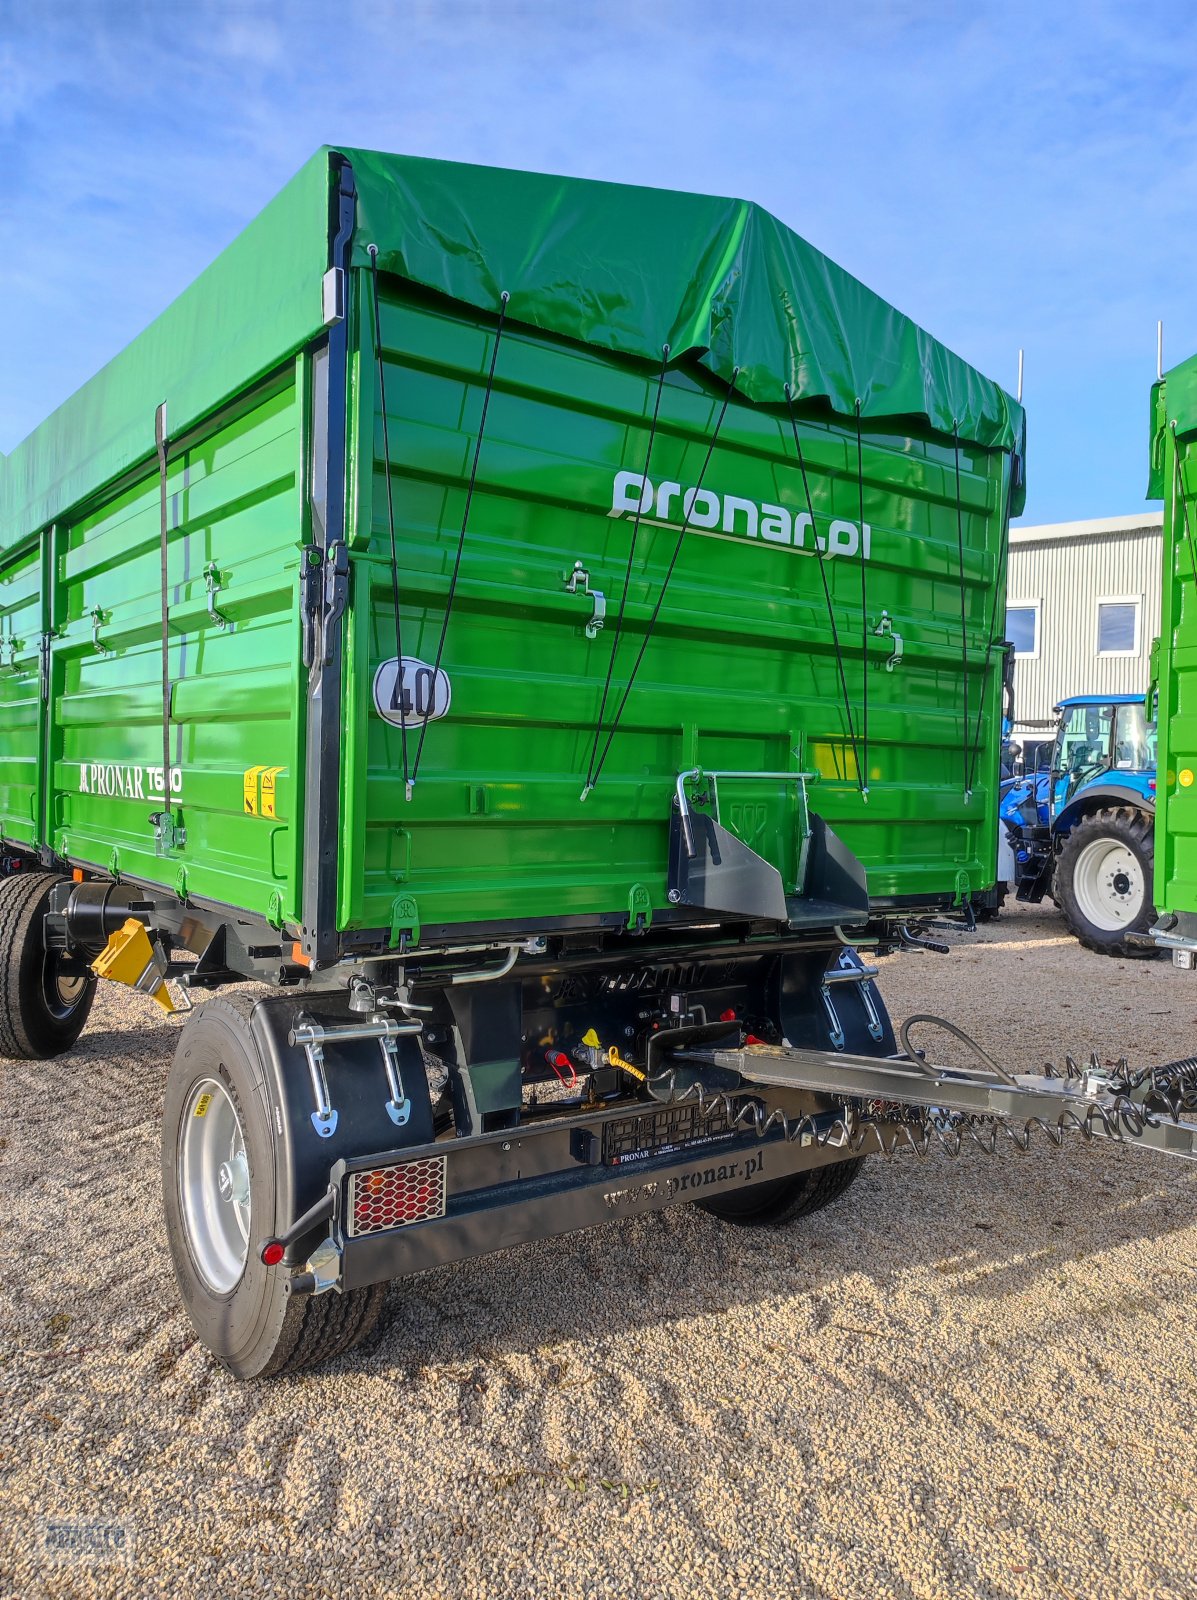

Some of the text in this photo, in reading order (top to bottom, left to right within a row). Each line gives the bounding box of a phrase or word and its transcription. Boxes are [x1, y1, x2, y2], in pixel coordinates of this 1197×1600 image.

[607, 470, 870, 560] pronar.pl
[390, 667, 436, 716] 40
[90, 764, 182, 800] PRONAR T60
[604, 1151, 764, 1208] www.pronar.pl
[620, 1150, 649, 1163] PRONAR
